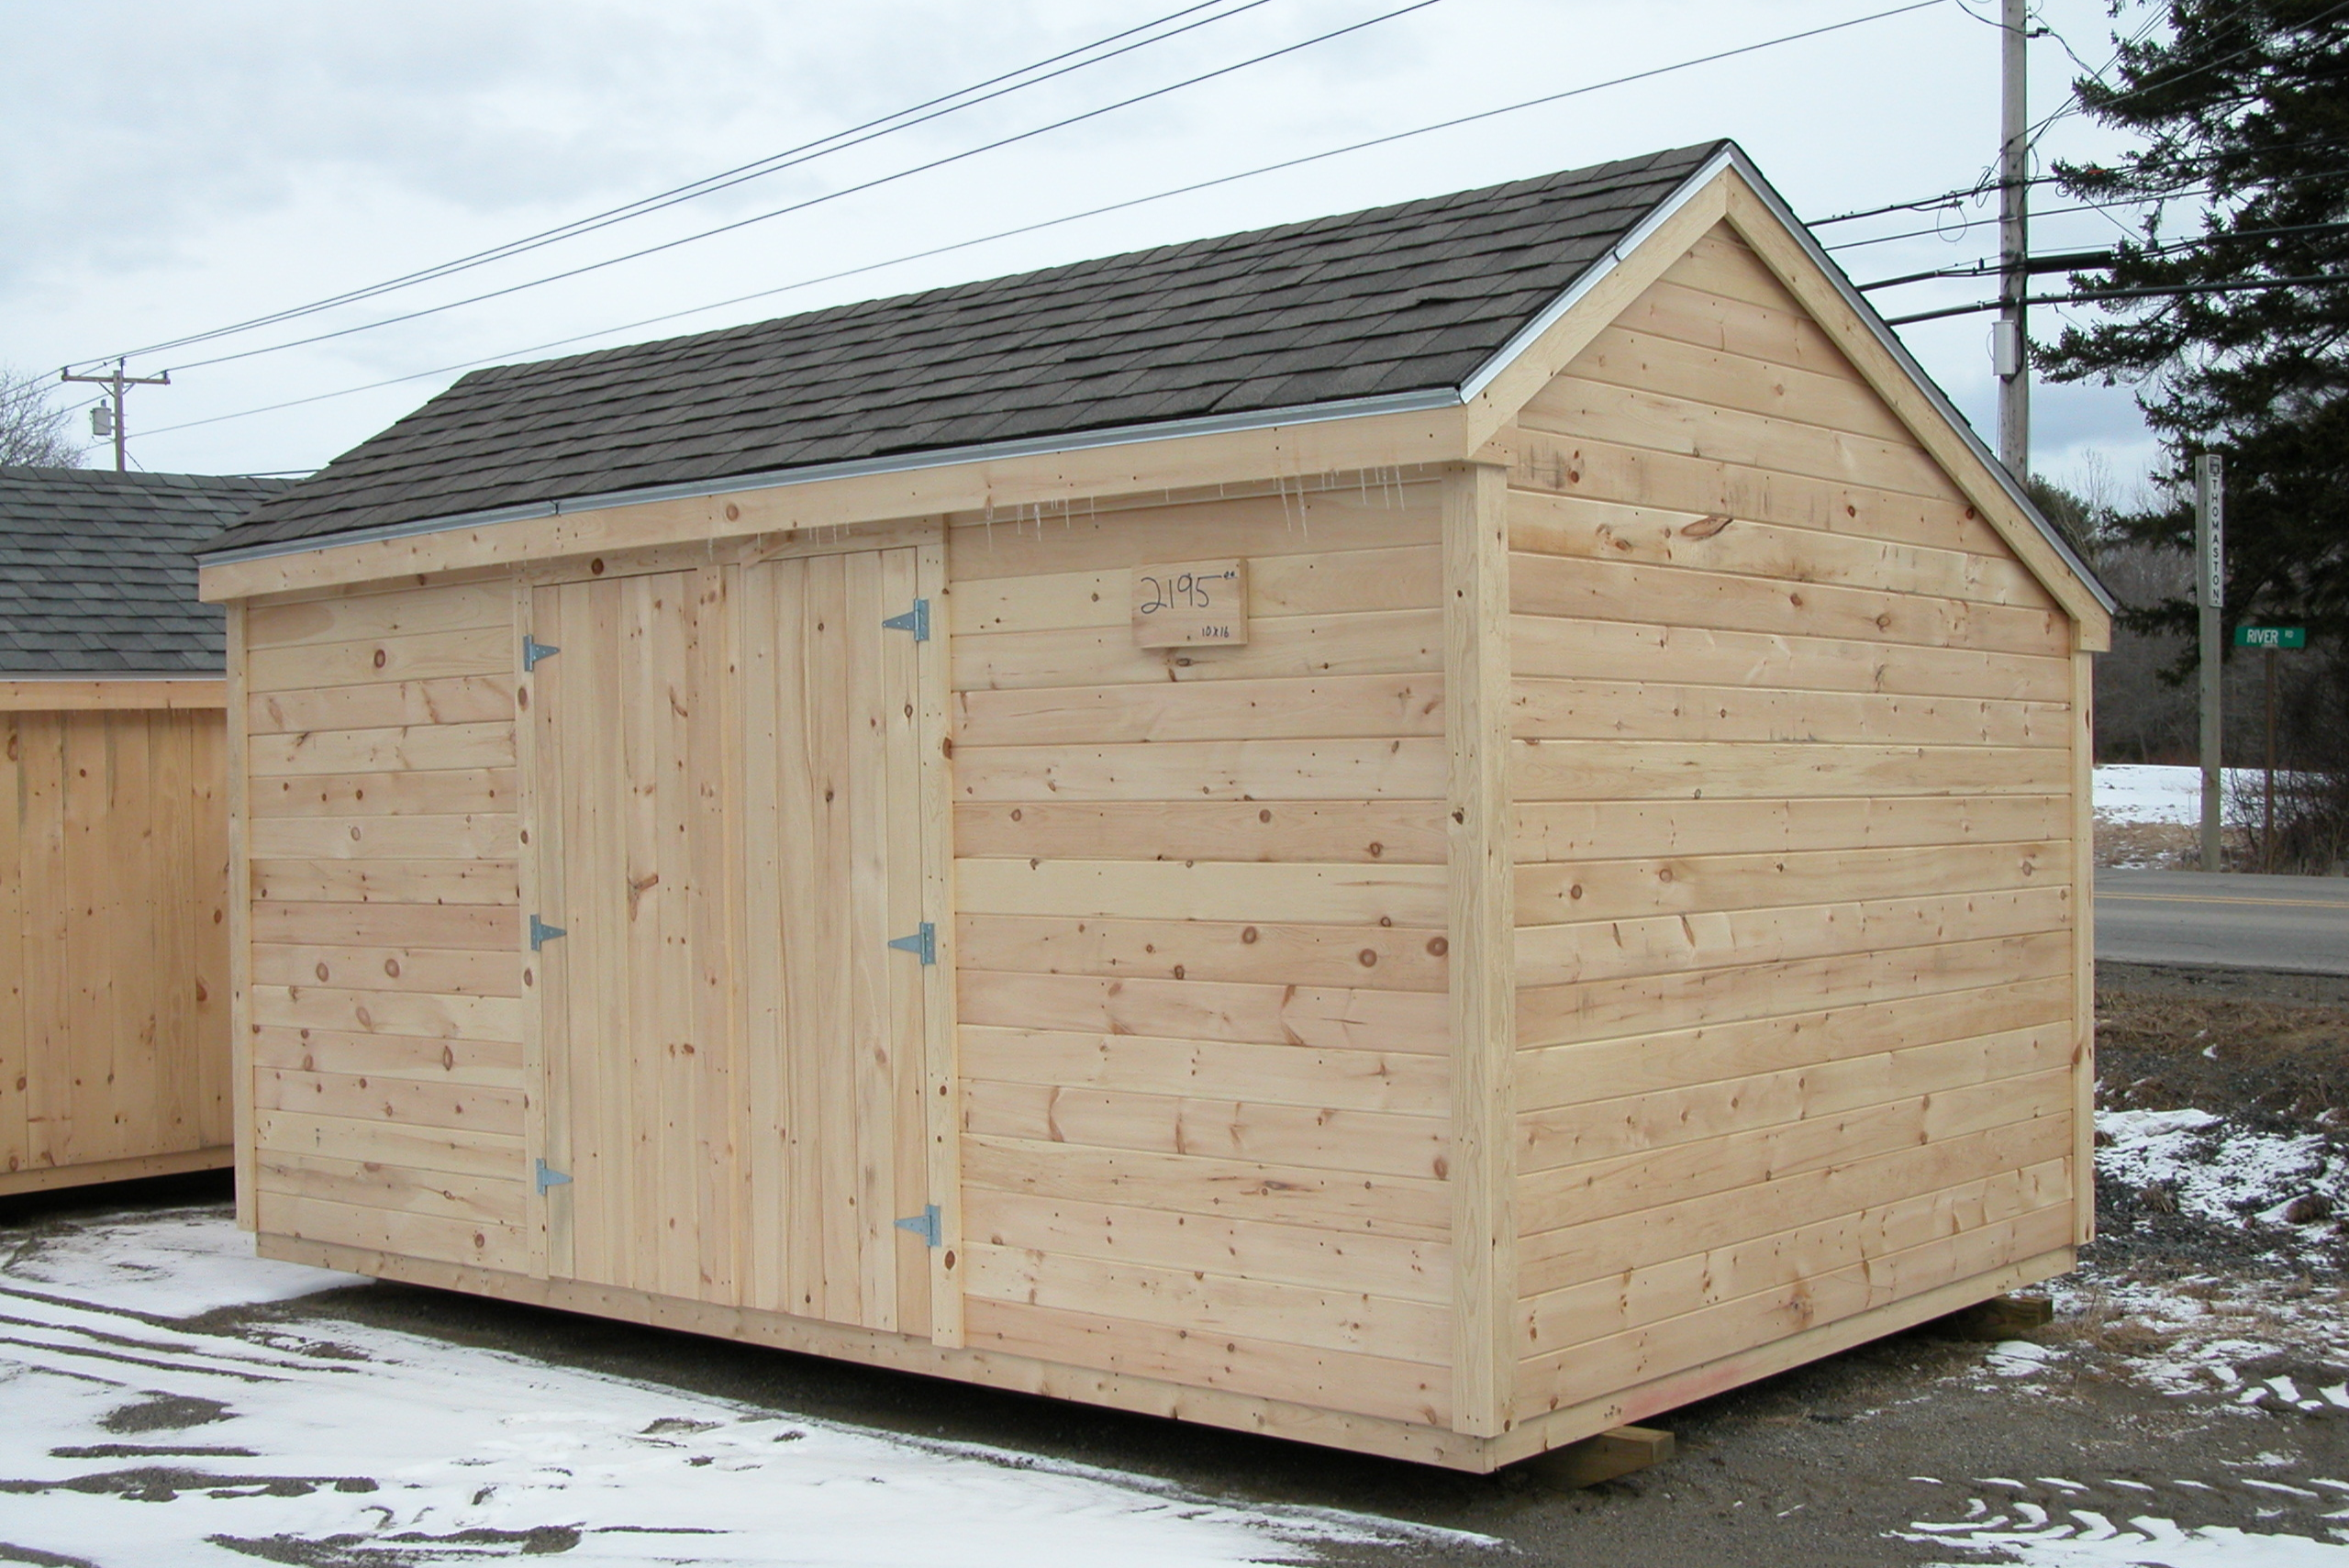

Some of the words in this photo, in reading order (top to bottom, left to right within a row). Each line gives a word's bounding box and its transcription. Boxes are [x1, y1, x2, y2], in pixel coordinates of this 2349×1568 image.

[2211, 479, 2221, 599] THOMASTON
[2246, 628, 2279, 644] RIVER
[2284, 629, 2294, 639] RD
